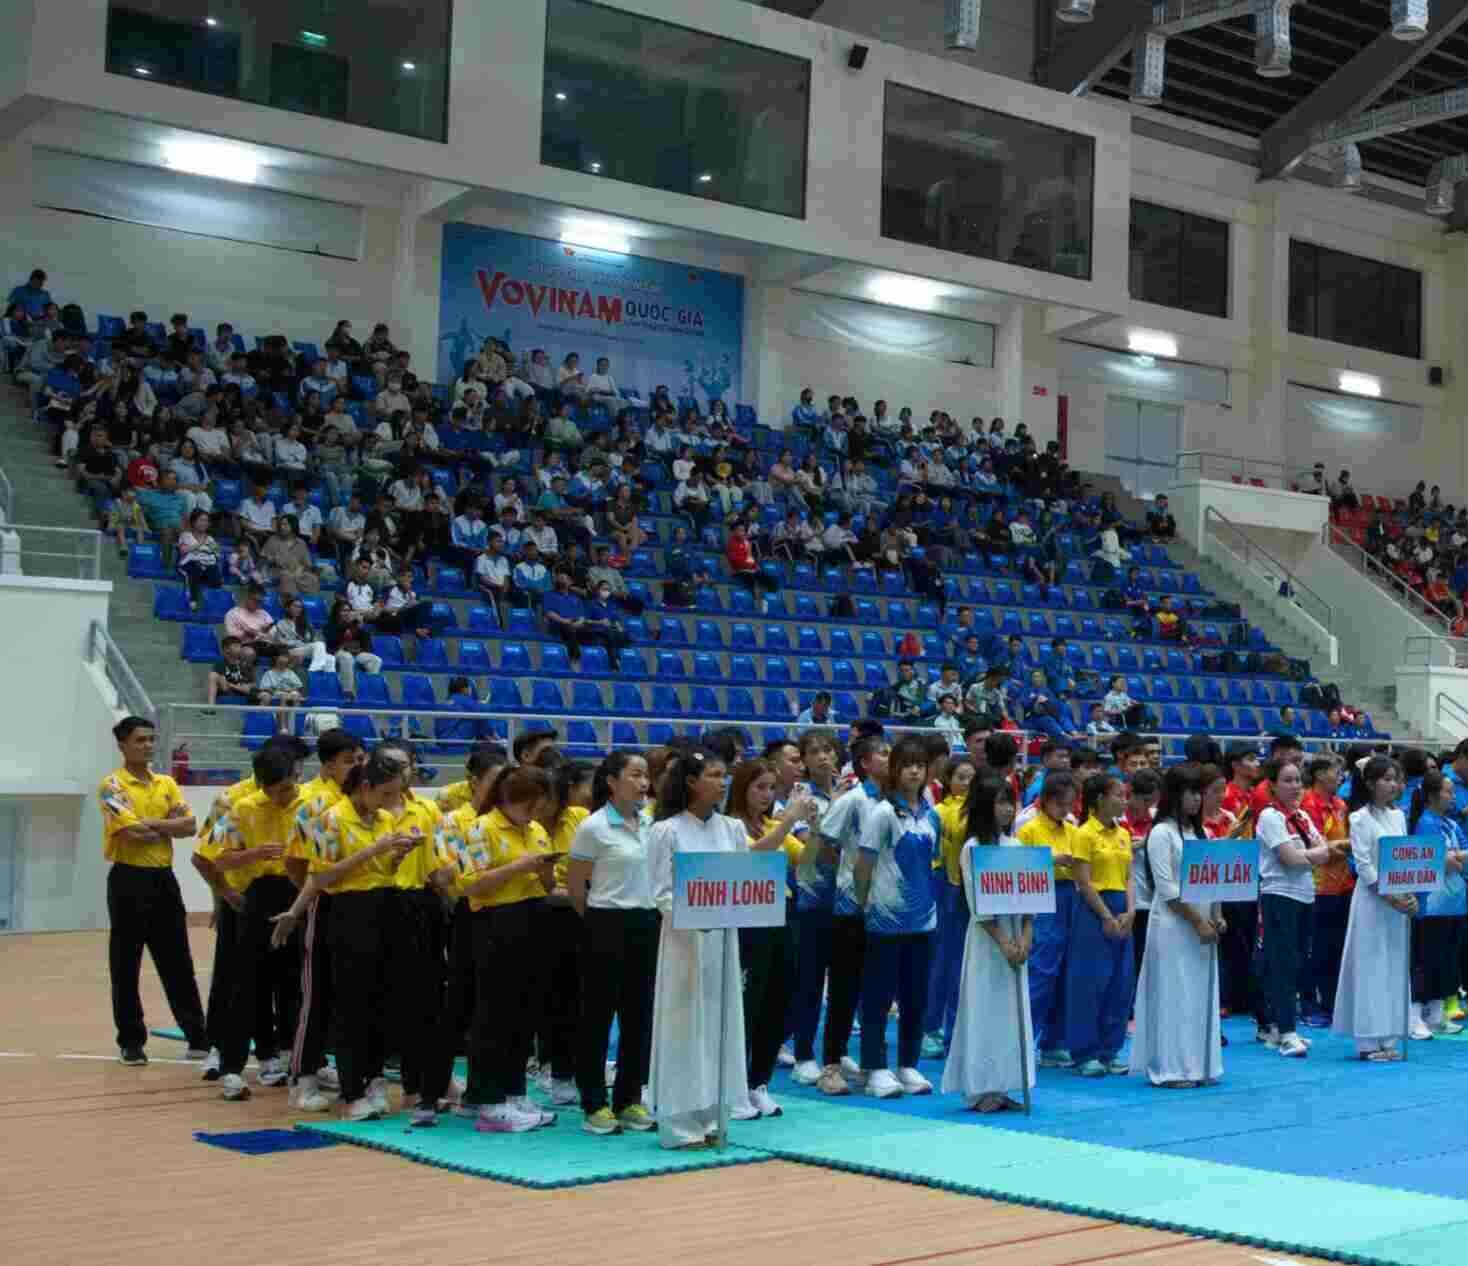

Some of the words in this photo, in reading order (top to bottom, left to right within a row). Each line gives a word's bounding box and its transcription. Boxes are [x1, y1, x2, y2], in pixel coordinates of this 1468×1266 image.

[476, 269, 623, 325] VOVINAM
[677, 306, 705, 329] GIA
[687, 876, 728, 907] VĨNH
[732, 879, 776, 906] LONG
[981, 871, 1013, 894] NINH
